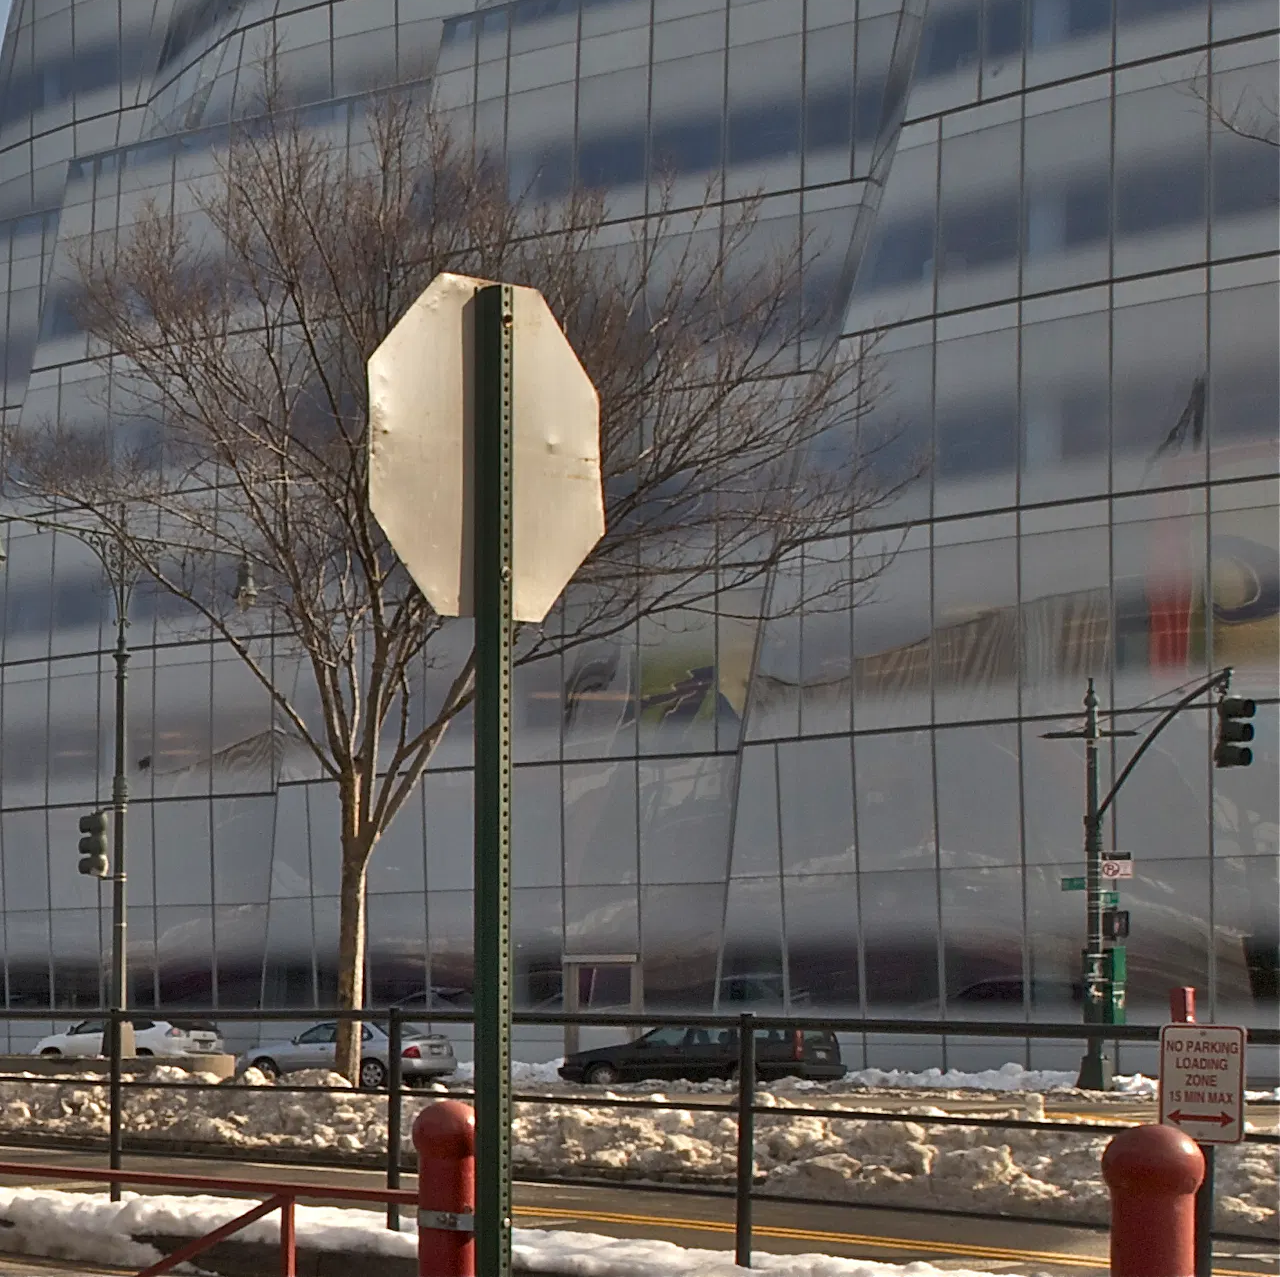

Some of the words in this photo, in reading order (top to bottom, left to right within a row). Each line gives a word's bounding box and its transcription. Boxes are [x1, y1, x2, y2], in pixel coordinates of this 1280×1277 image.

[1166, 1040, 1183, 1053] NO
[1185, 1041, 1240, 1055] PARKING
[1175, 1057, 1229, 1071] LOADING
[1185, 1073, 1218, 1087] ZONE
[1168, 1090, 1182, 1103] 15
[1184, 1091, 1206, 1104] MIN
[1208, 1092, 1233, 1105] MAX
